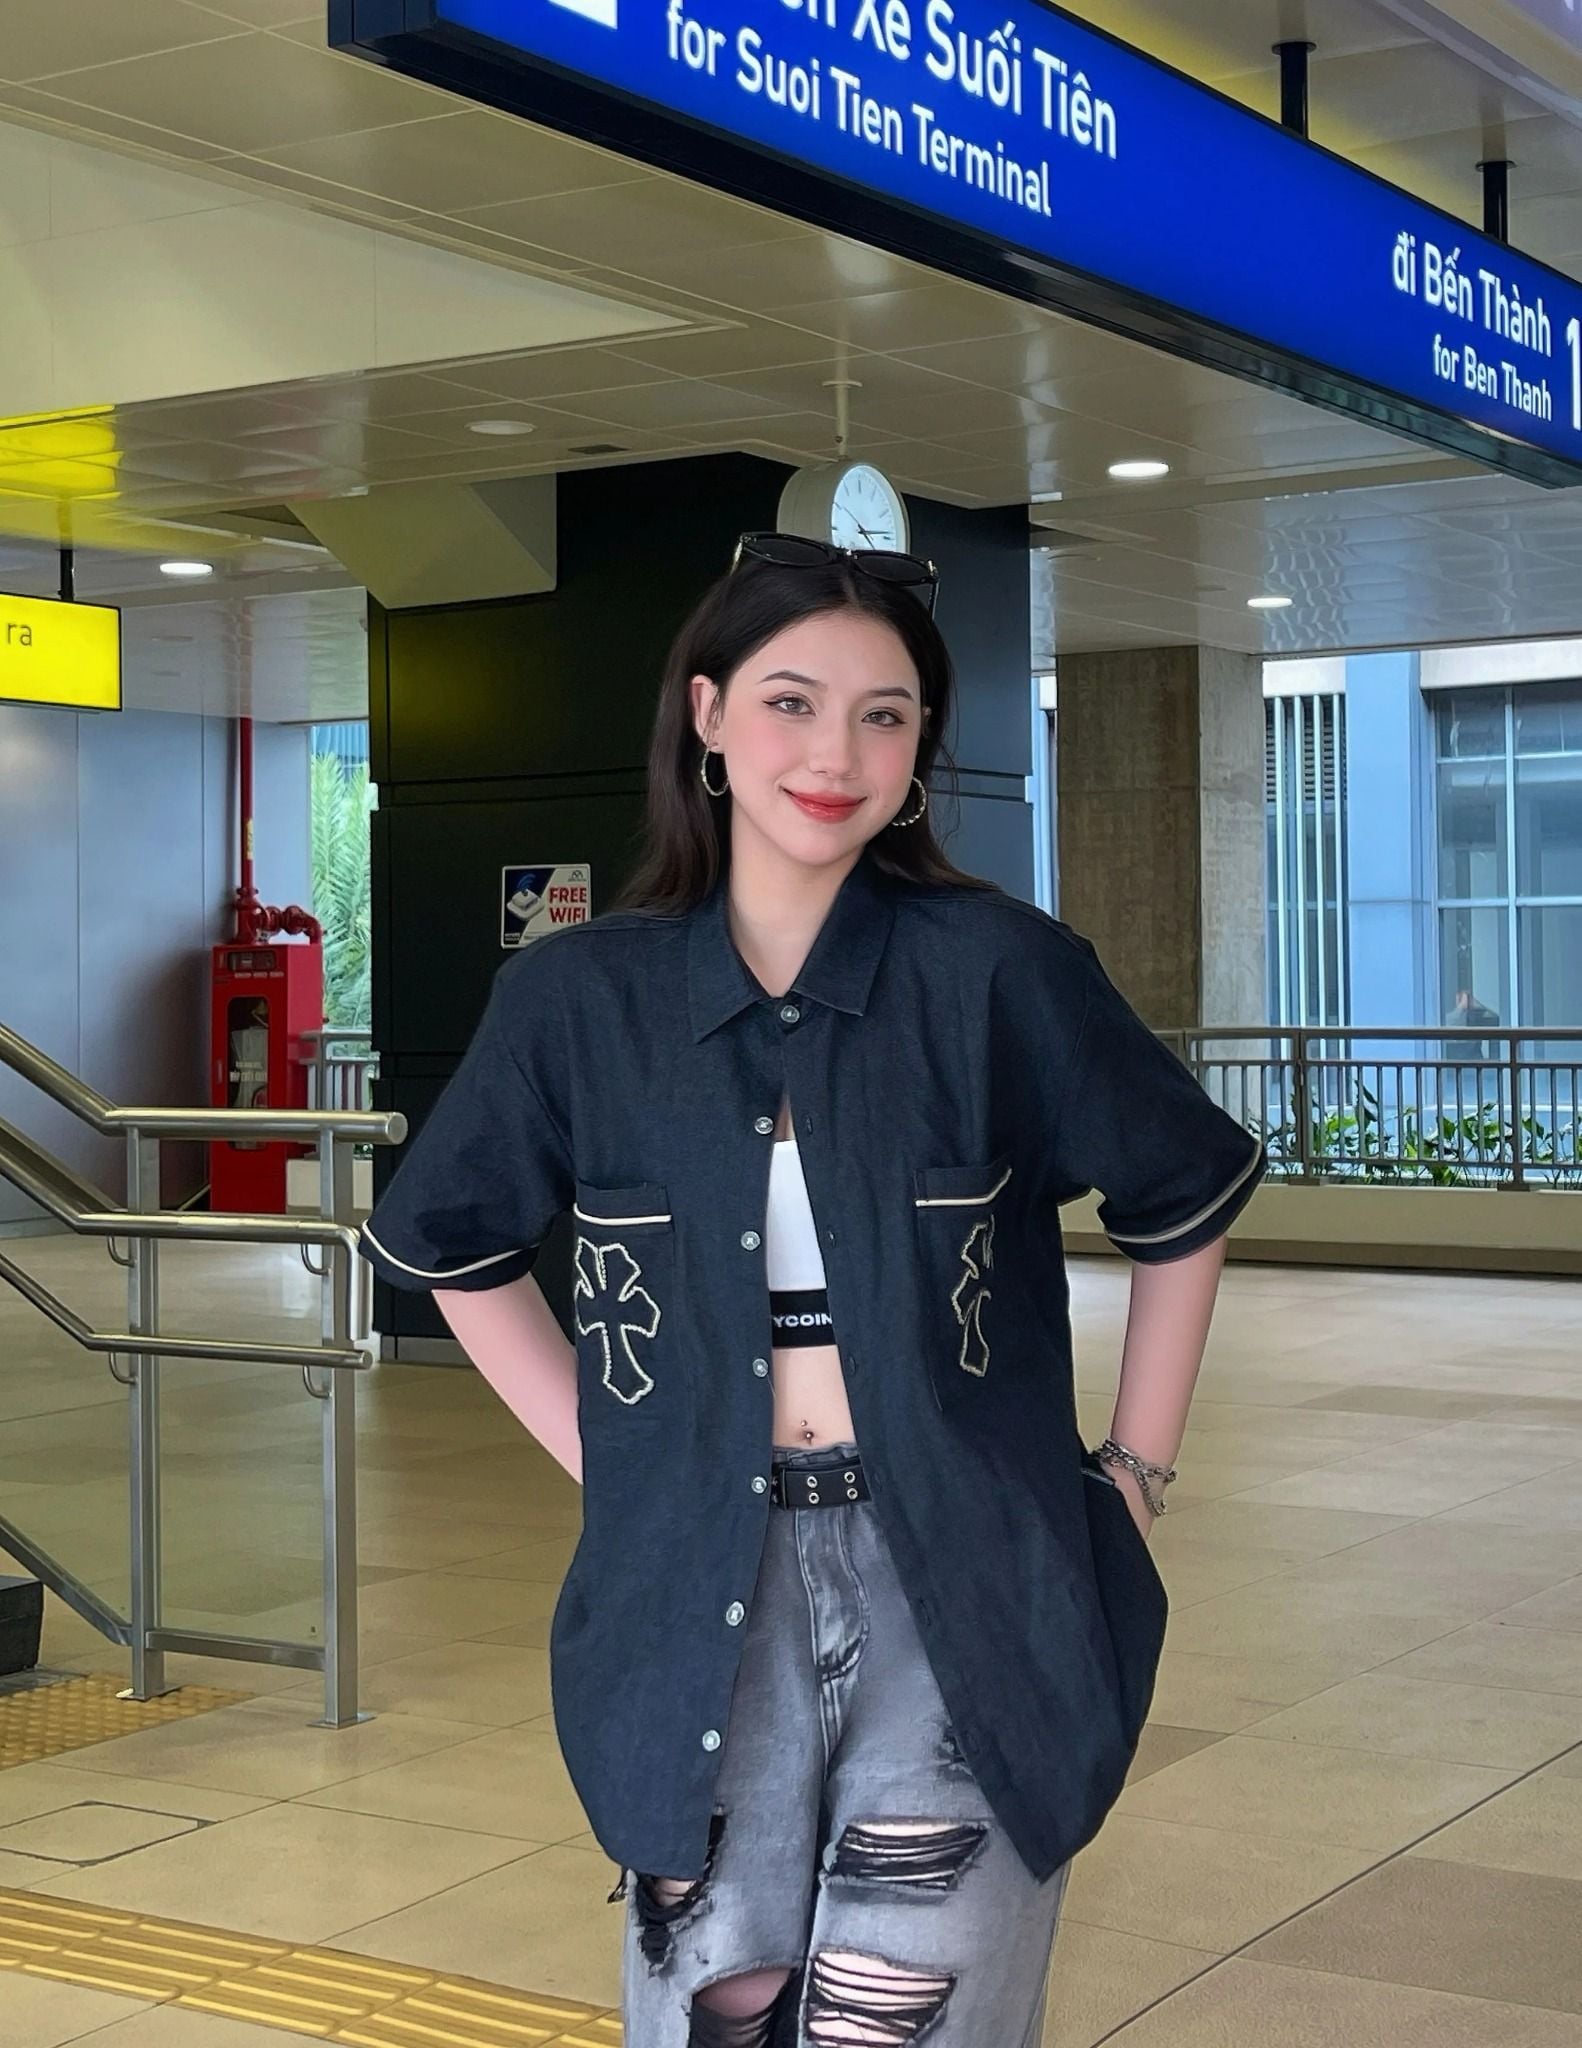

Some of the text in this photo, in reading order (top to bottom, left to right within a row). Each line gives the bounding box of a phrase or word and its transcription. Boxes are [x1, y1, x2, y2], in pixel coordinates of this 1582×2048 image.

[667, 0, 1052, 217] for Suoi Tien Terminal
[925, 0, 1022, 115] Suối
[1033, 47, 1117, 160] Tiên
[1393, 231, 1551, 357] đi Bến Thành
[1433, 333, 1552, 422] for Ben Thanh
[1566, 317, 1582, 431] 1
[7, 622, 32, 647] ra
[548, 887, 587, 904] FREE
[549, 907, 586, 924] WIFI
